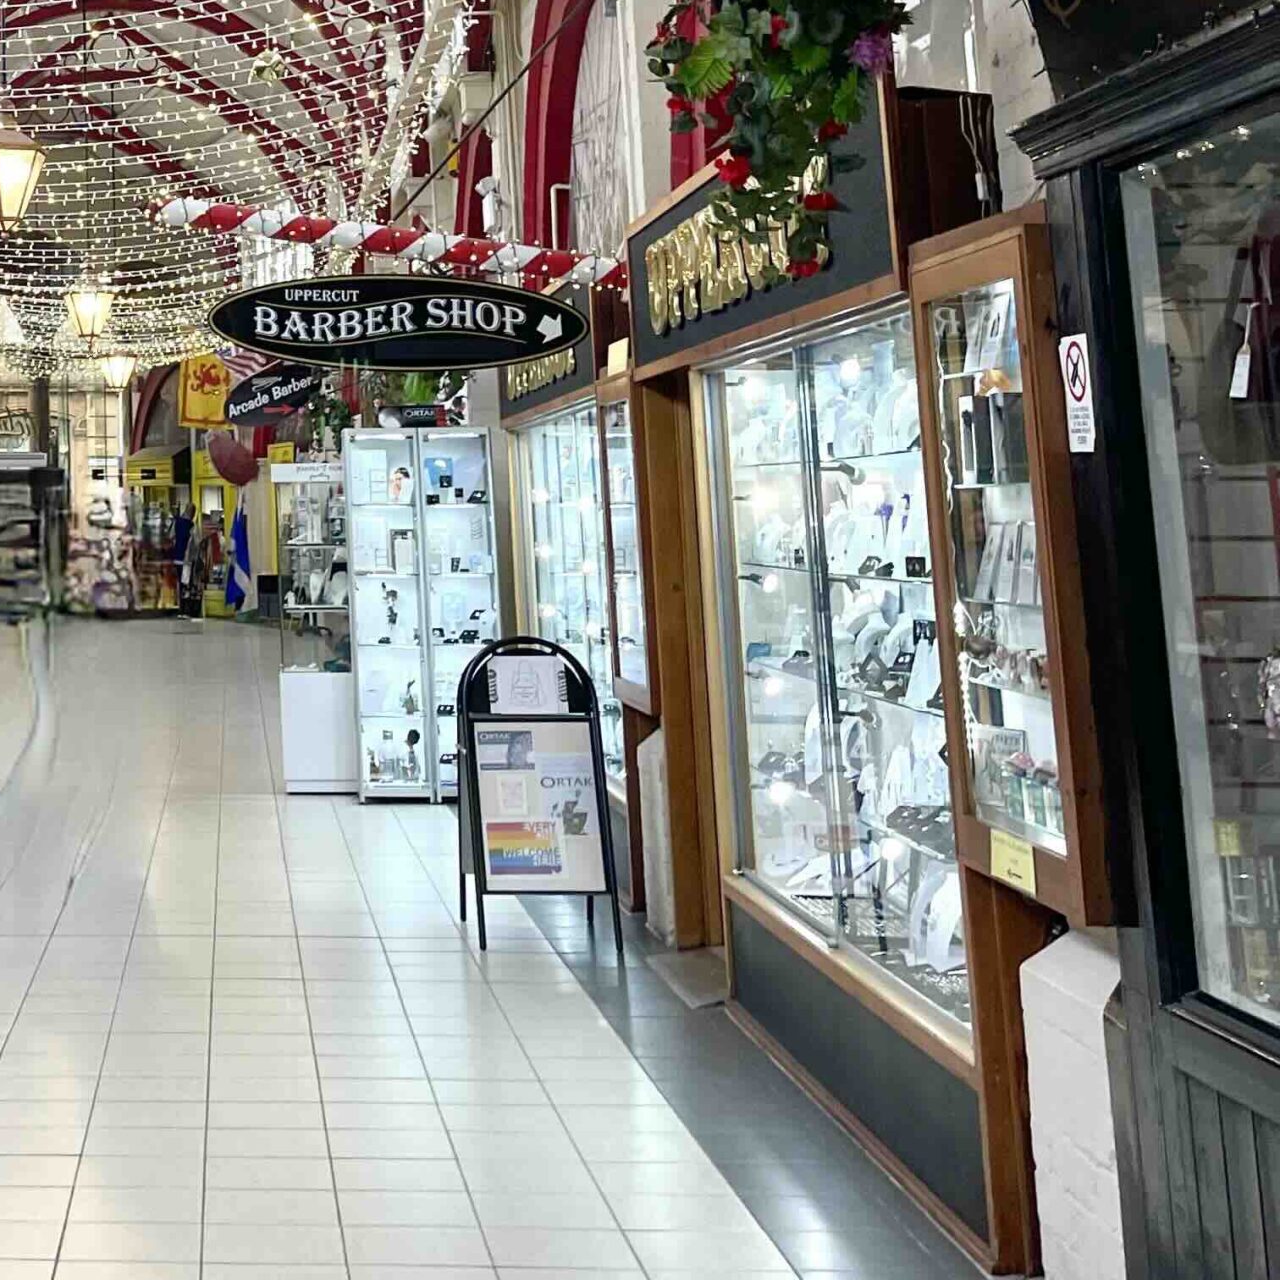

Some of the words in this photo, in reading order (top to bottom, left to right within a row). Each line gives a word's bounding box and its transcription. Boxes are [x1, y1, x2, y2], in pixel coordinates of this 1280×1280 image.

[285, 289, 360, 303] UPPERCUT
[254, 302, 418, 344] BARBER
[426, 298, 526, 336] SHOP
[228, 391, 270, 419] Arcade
[540, 776, 594, 789] ORTAK
